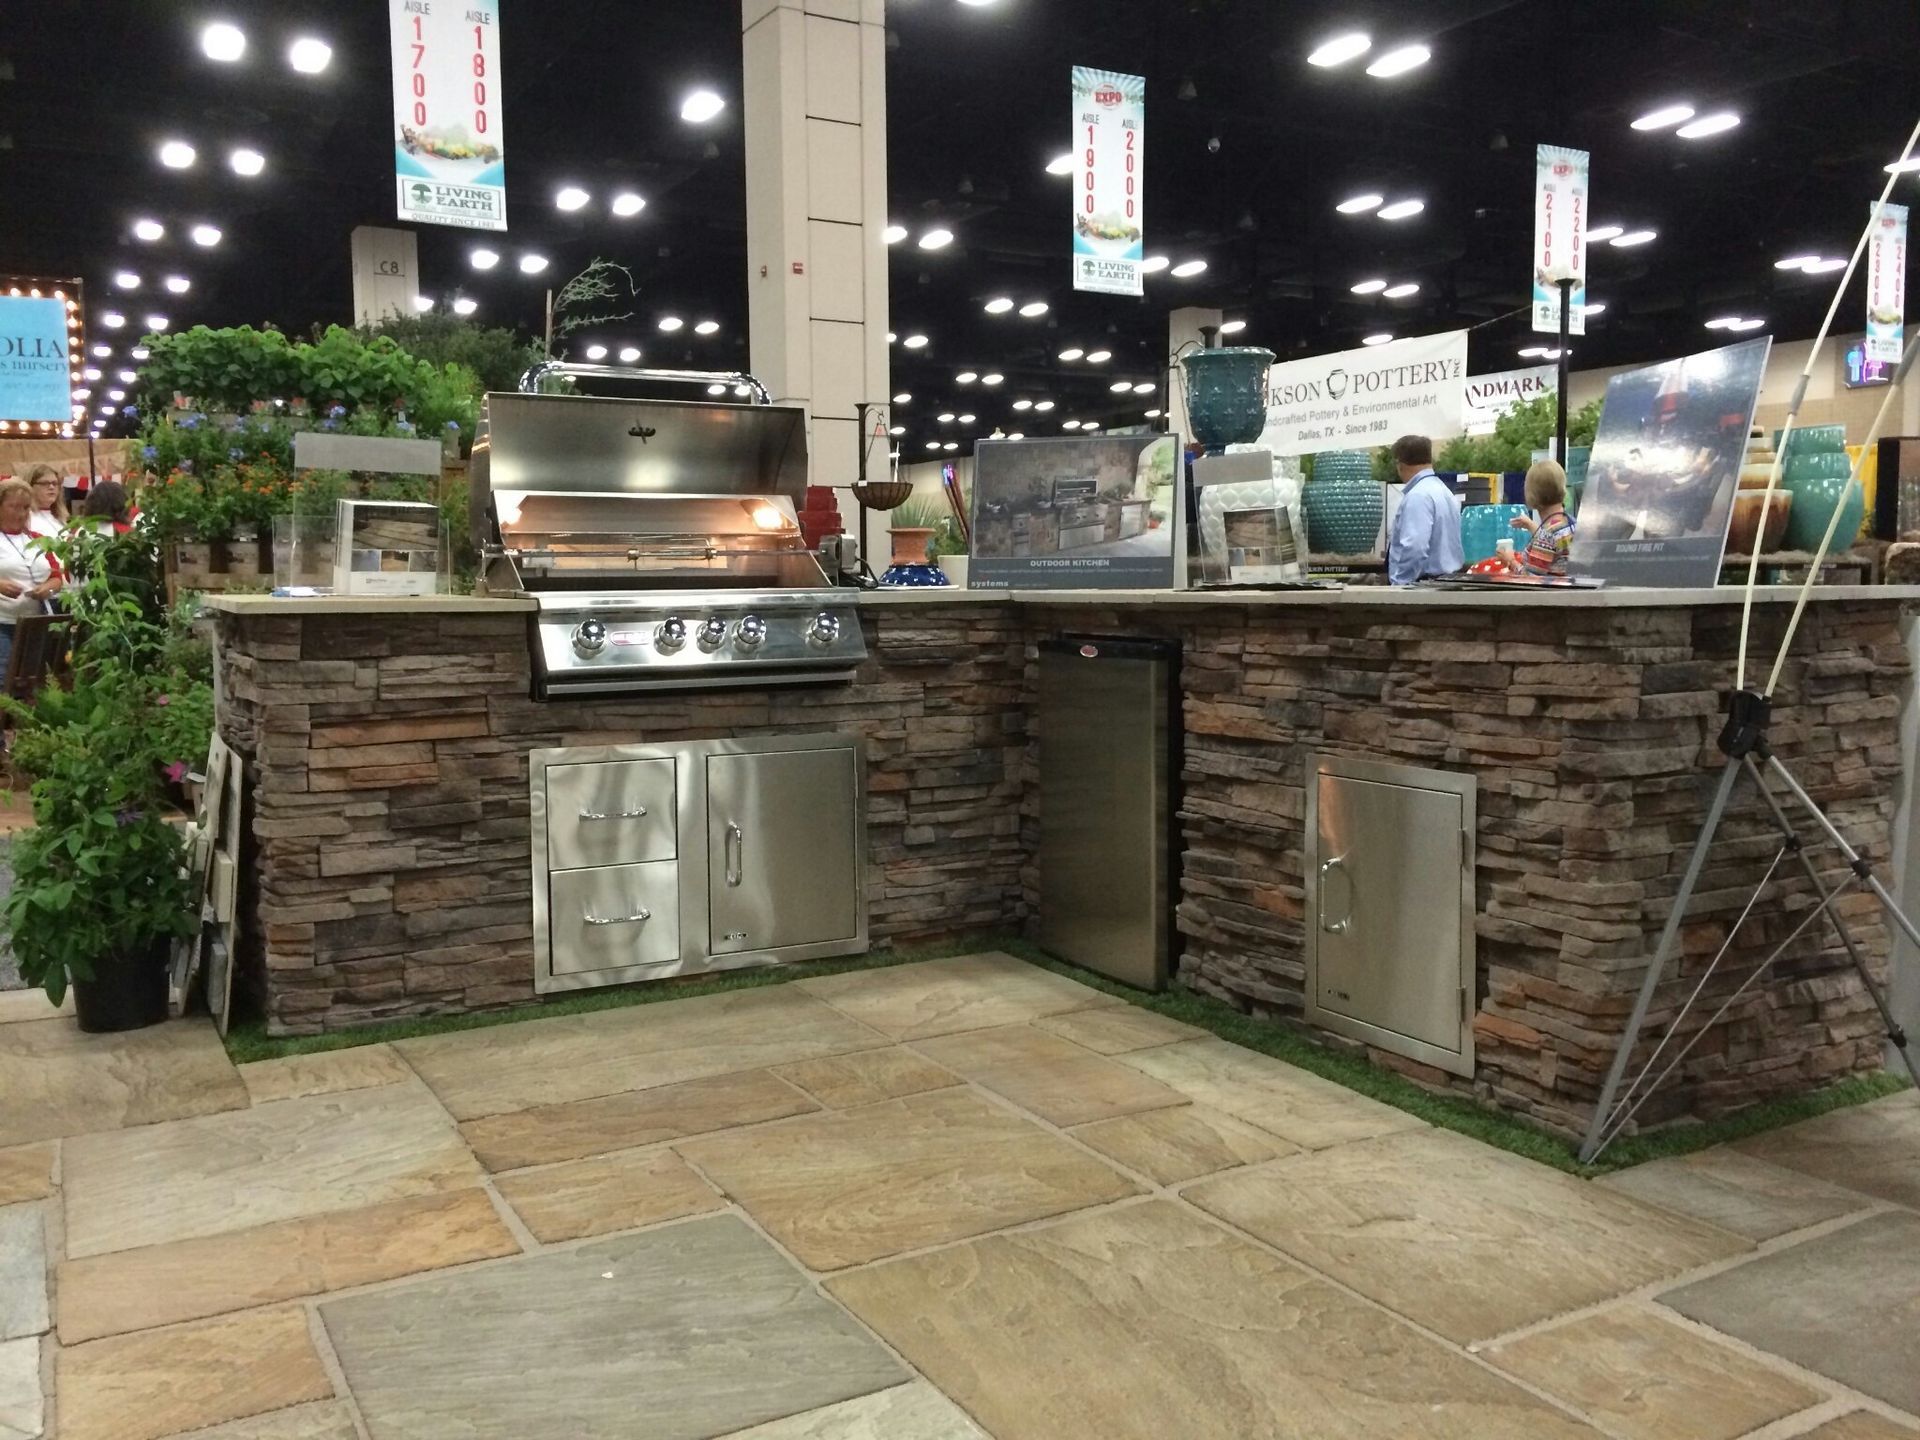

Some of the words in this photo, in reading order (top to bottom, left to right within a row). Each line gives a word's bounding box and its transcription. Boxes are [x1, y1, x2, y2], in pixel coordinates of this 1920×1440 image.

[404, 0, 430, 15] AISLE
[465, 10, 490, 24] AISLE
[411, 16, 426, 126] 1700
[473, 26, 487, 133] 1800
[1095, 92, 1121, 103] EXPO
[1082, 113, 1100, 124] AISLE
[1086, 125, 1094, 214] 1900
[1126, 130, 1134, 218] 2000
[436, 187, 492, 200] LIVING
[436, 197, 492, 211] EARTH
[1544, 193, 1552, 267] 2100
[380, 260, 399, 274] C8
[1098, 262, 1135, 272] LIVING
[1098, 270, 1135, 280] EARTH
[1271, 380, 1321, 407] KSON
[1353, 358, 1452, 394] POTTERY
[1309, 409, 1340, 421] Pottery
[1343, 406, 1349, 417] &
[1352, 396, 1420, 416] Environmental
[1422, 394, 1437, 405] Art
[1298, 430, 1322, 441] Dallas,
[1324, 427, 1335, 437] TX
[1345, 423, 1367, 434] Since
[1369, 420, 1388, 432] 1983
[1072, 559, 1110, 567] KITCHEN
[971, 580, 1009, 588] systems
